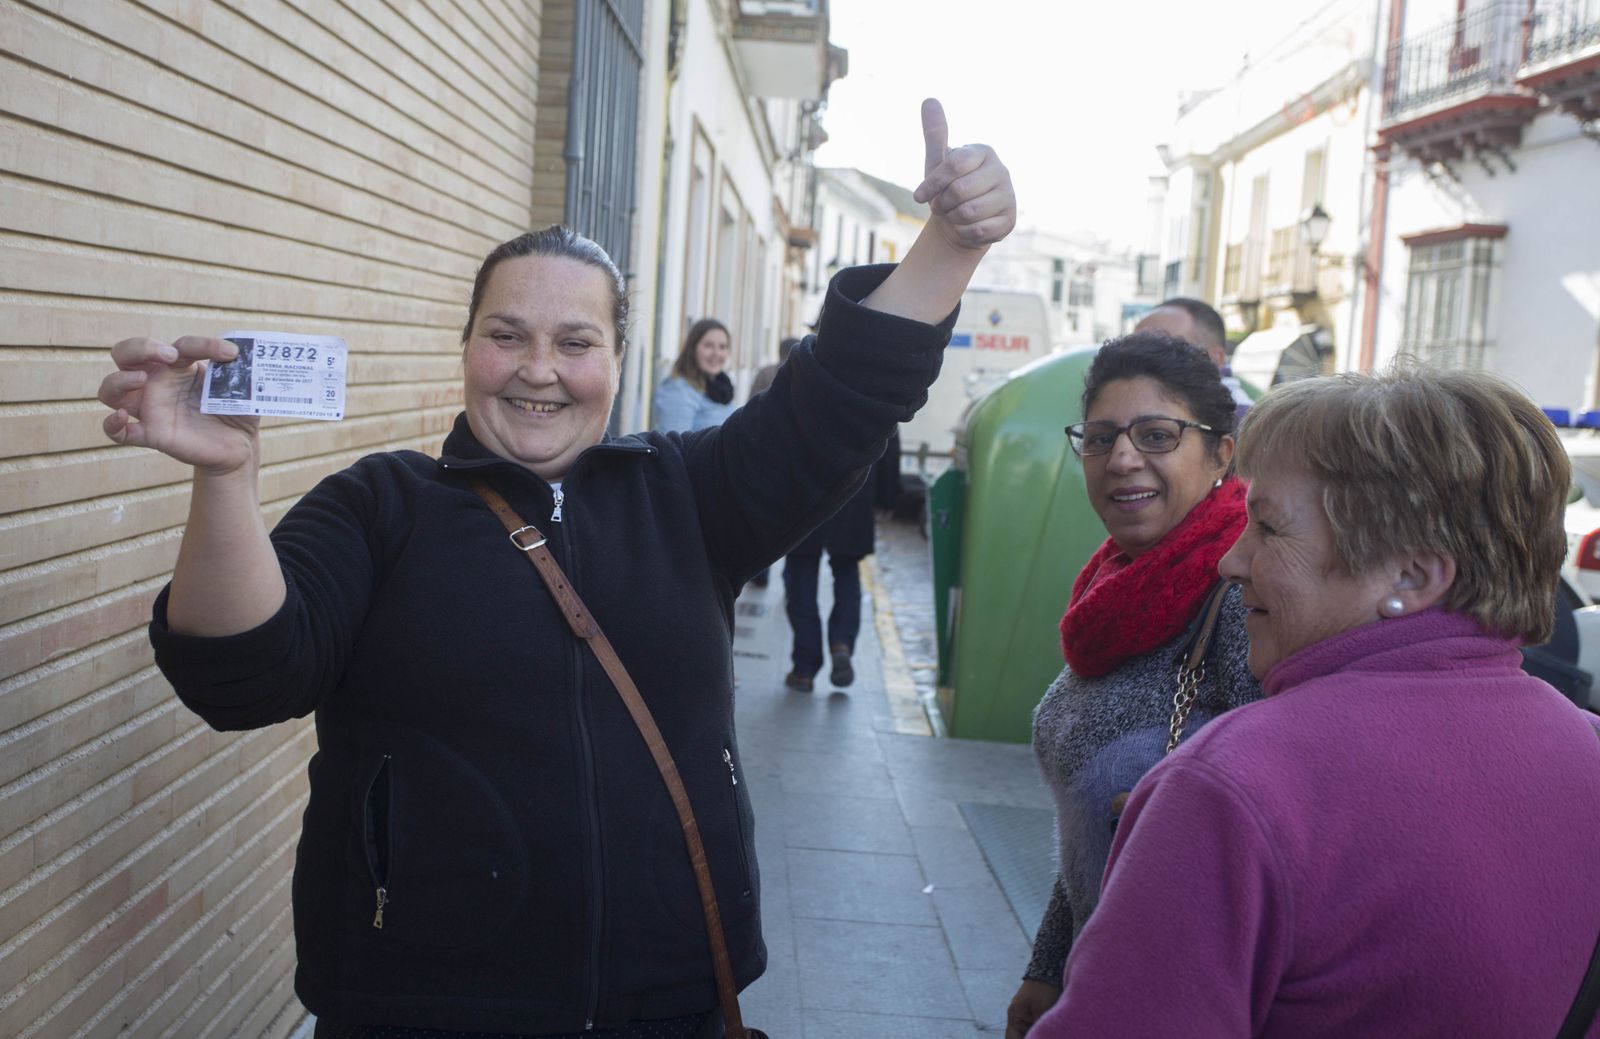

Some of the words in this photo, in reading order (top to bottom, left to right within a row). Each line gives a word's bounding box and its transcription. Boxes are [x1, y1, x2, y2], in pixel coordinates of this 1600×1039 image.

[975, 333, 1030, 352] SEUR
[256, 345, 317, 360] 37872
[326, 390, 336, 398] 20
